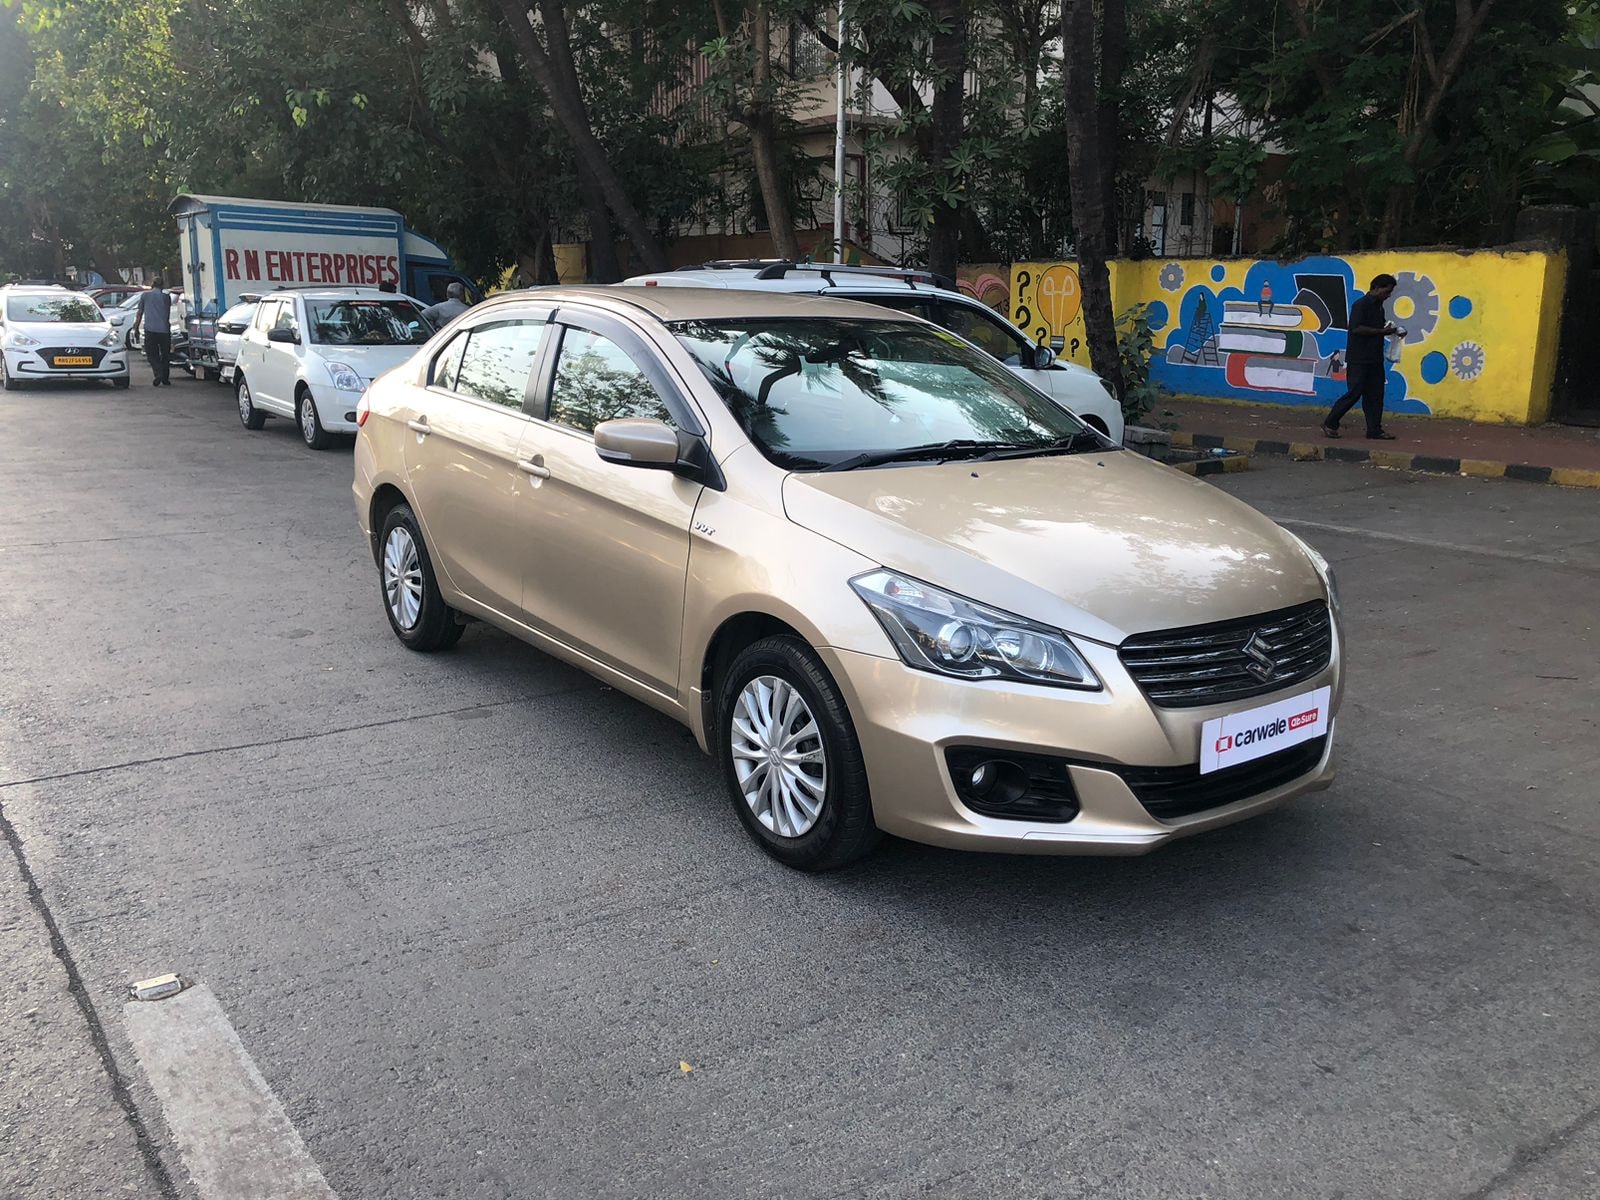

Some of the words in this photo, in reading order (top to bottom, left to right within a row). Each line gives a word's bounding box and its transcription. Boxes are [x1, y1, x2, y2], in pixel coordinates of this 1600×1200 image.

[225, 249, 241, 280] R
[244, 250, 261, 281] N
[265, 250, 400, 285] ENTERPRISES
[1234, 717, 1287, 748] carwale
